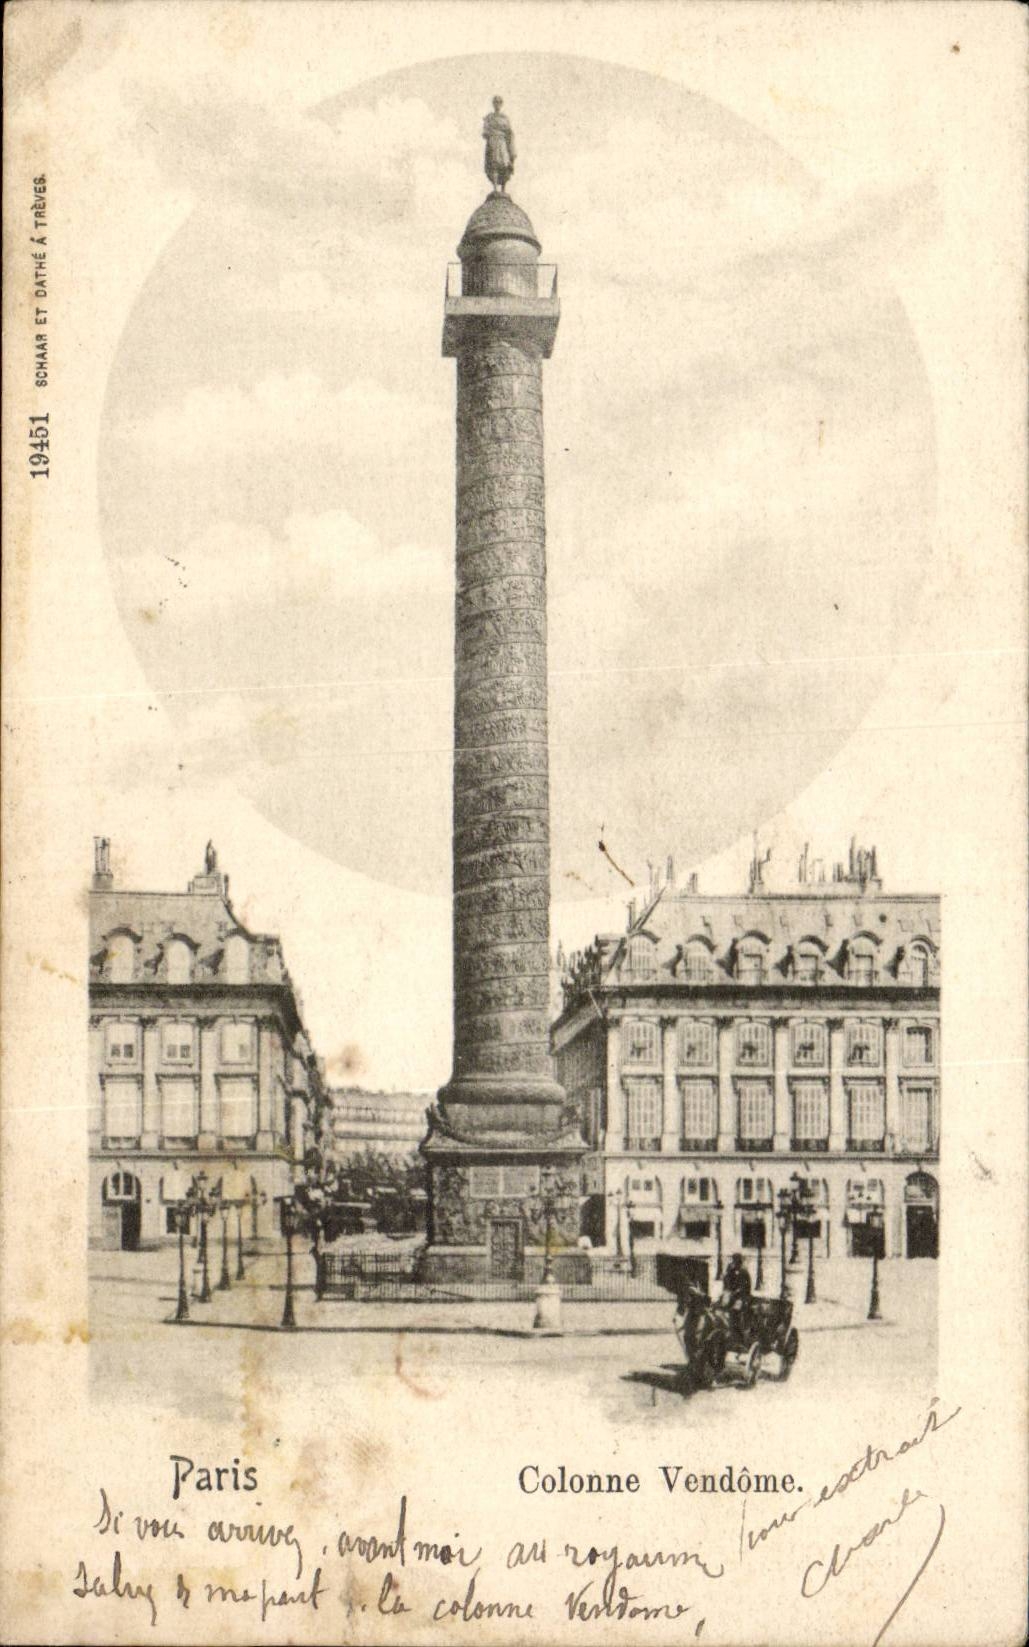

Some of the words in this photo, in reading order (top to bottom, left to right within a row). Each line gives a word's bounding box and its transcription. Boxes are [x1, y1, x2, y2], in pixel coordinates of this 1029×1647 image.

[93, 1487, 124, 1535] Si
[134, 1515, 185, 1541] vous
[412, 1532, 483, 1567] moi
[506, 1538, 547, 1570] au
[378, 1572, 413, 1616] la
[432, 1567, 536, 1622] colonne
